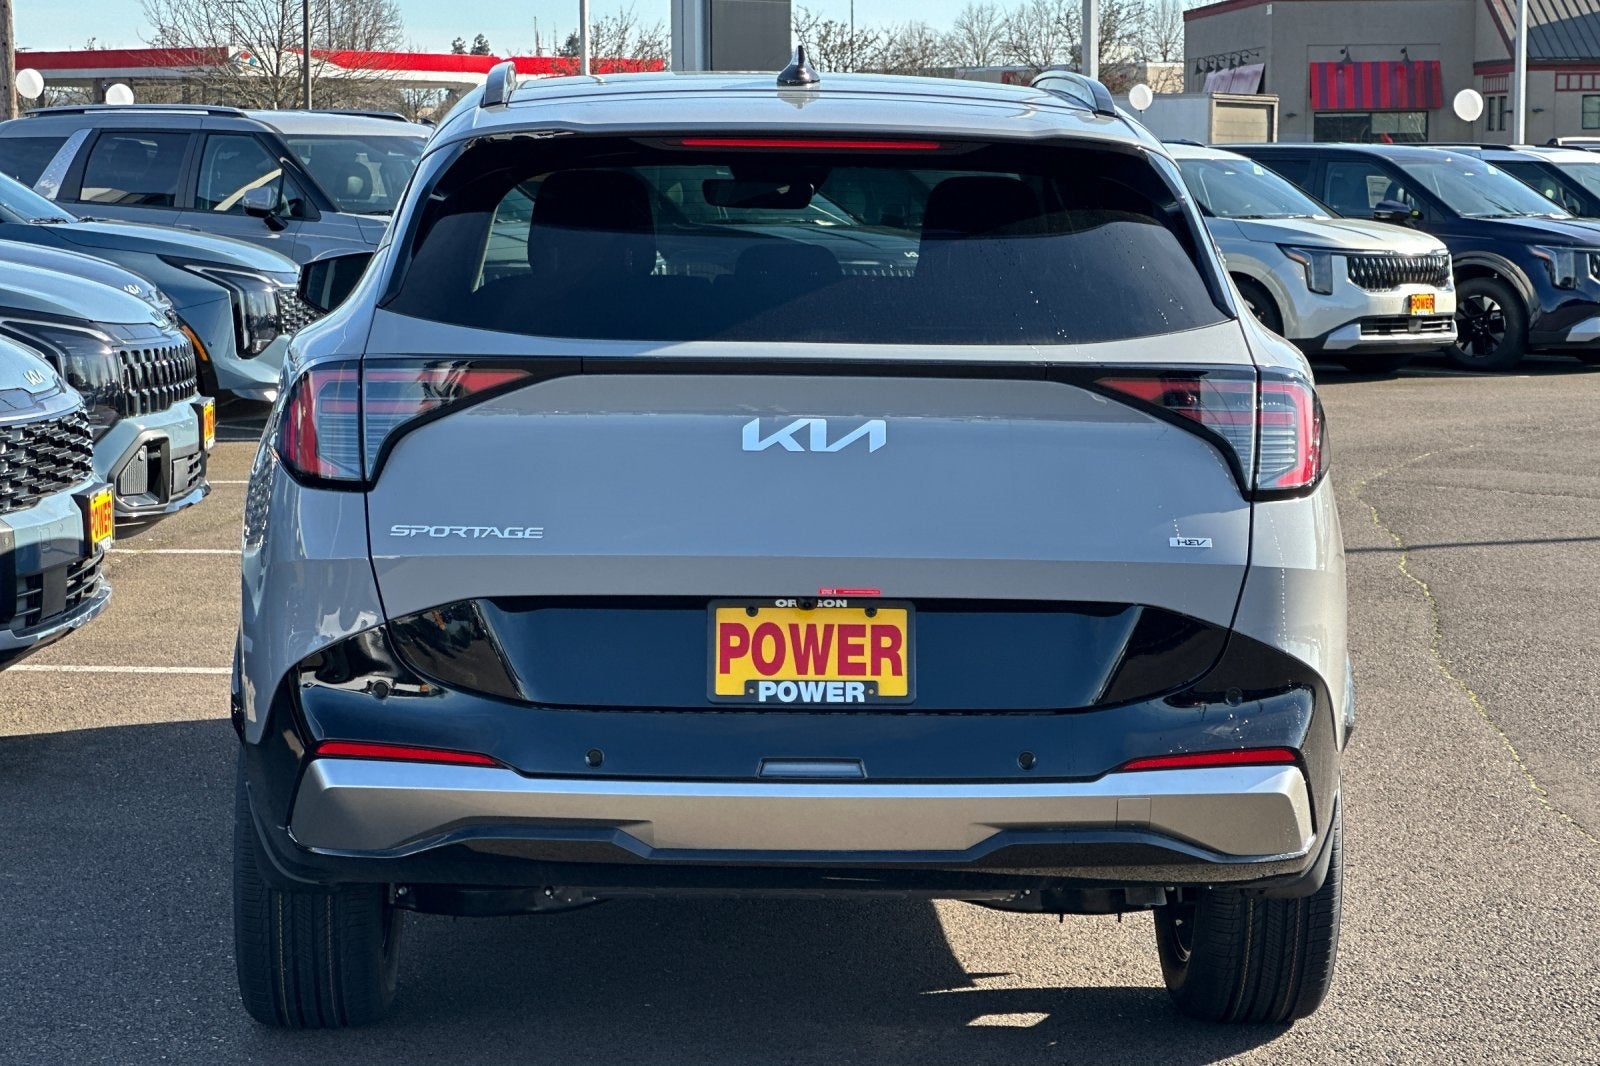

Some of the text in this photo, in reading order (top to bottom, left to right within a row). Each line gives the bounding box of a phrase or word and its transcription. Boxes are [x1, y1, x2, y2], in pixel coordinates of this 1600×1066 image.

[1411, 298, 1435, 309] POWER
[742, 417, 887, 453] KIA
[90, 500, 111, 539] POWER
[390, 524, 544, 539] SPORTAGE
[775, 599, 847, 608] ORGON
[719, 622, 903, 676] POWER
[758, 681, 865, 703] POWER
